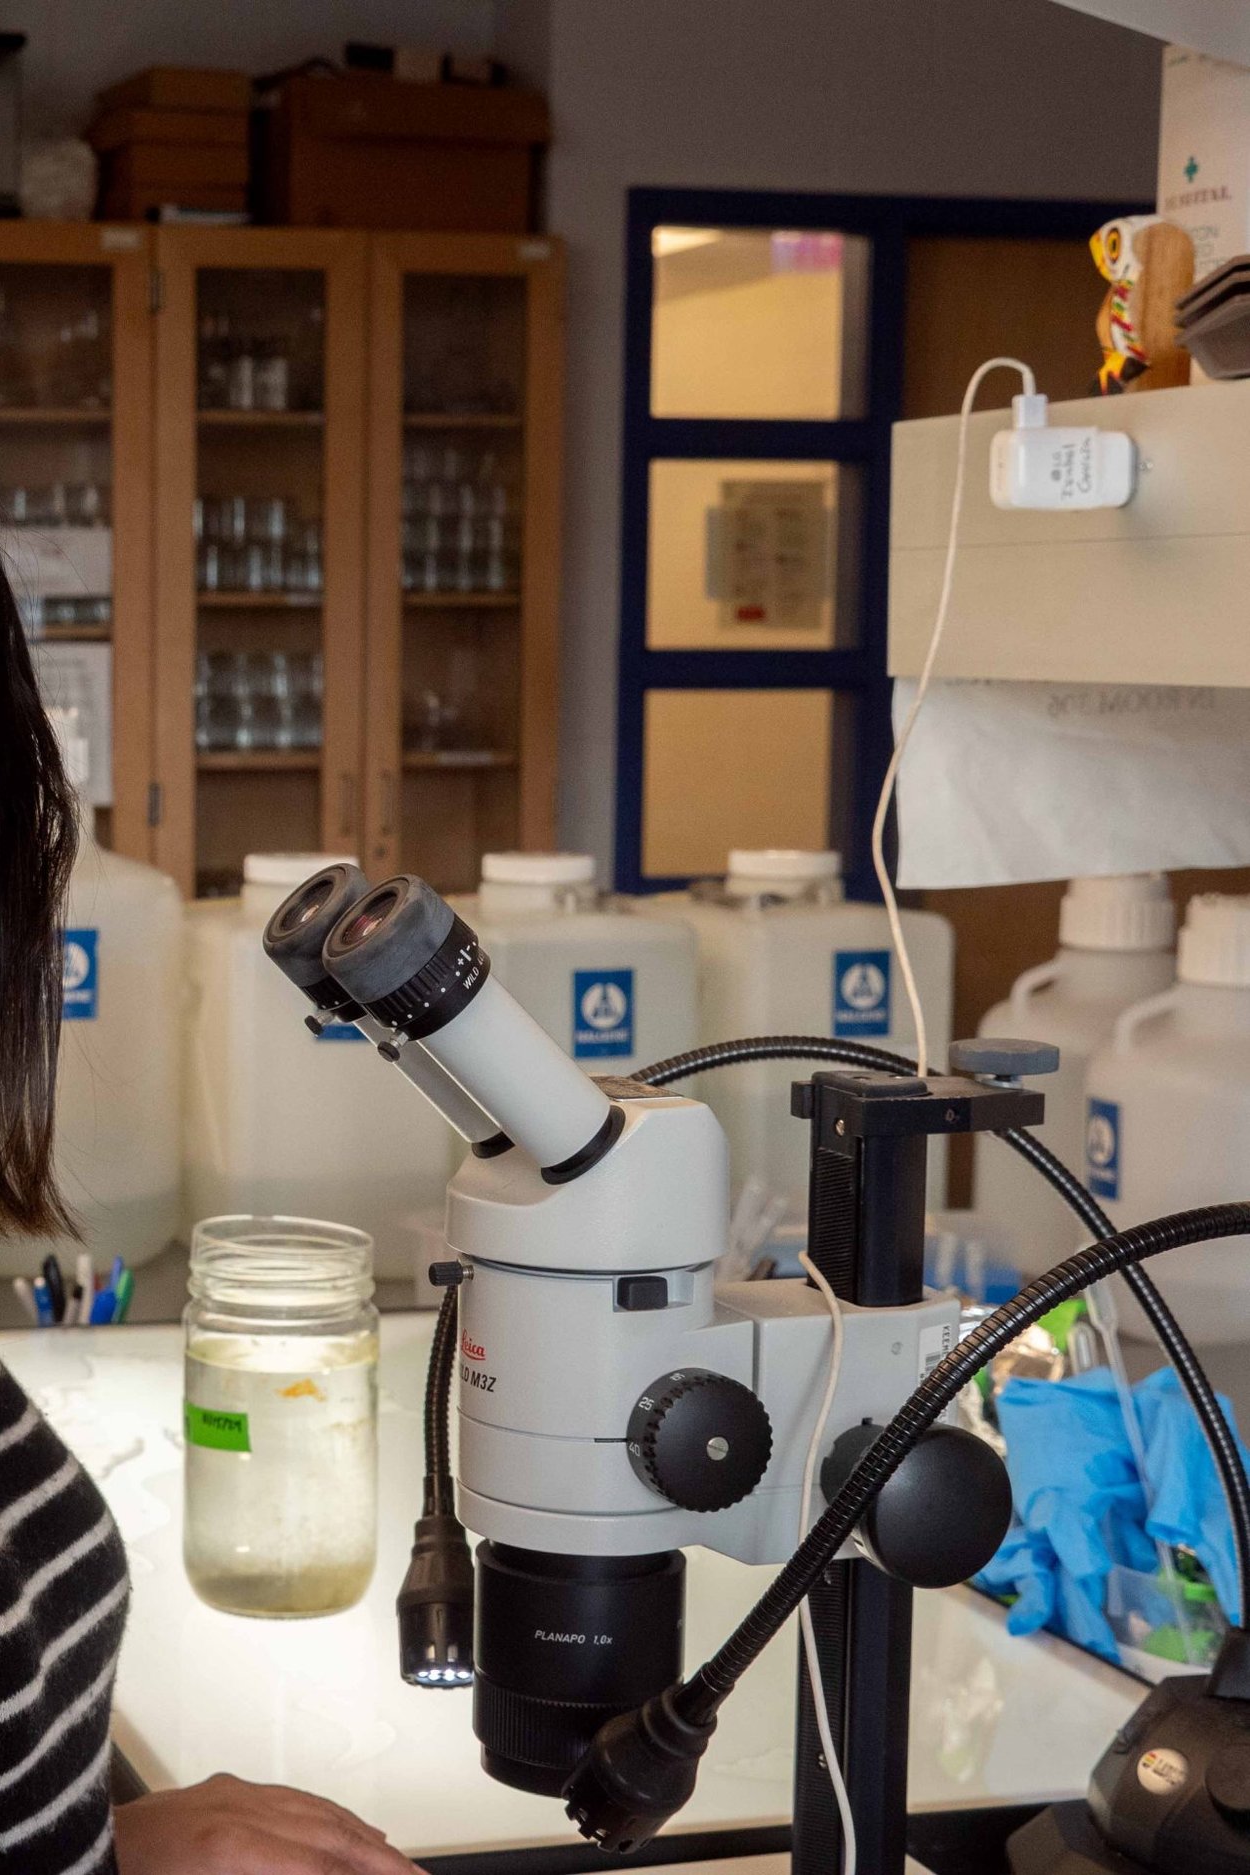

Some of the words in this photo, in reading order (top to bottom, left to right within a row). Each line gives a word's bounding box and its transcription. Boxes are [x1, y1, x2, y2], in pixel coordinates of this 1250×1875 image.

[463, 966, 479, 989] WILD
[470, 1370, 497, 1392] M3Z
[638, 1396, 655, 1411] 25
[628, 1441, 641, 1457] 40
[534, 1629, 586, 1644] PLANAPO
